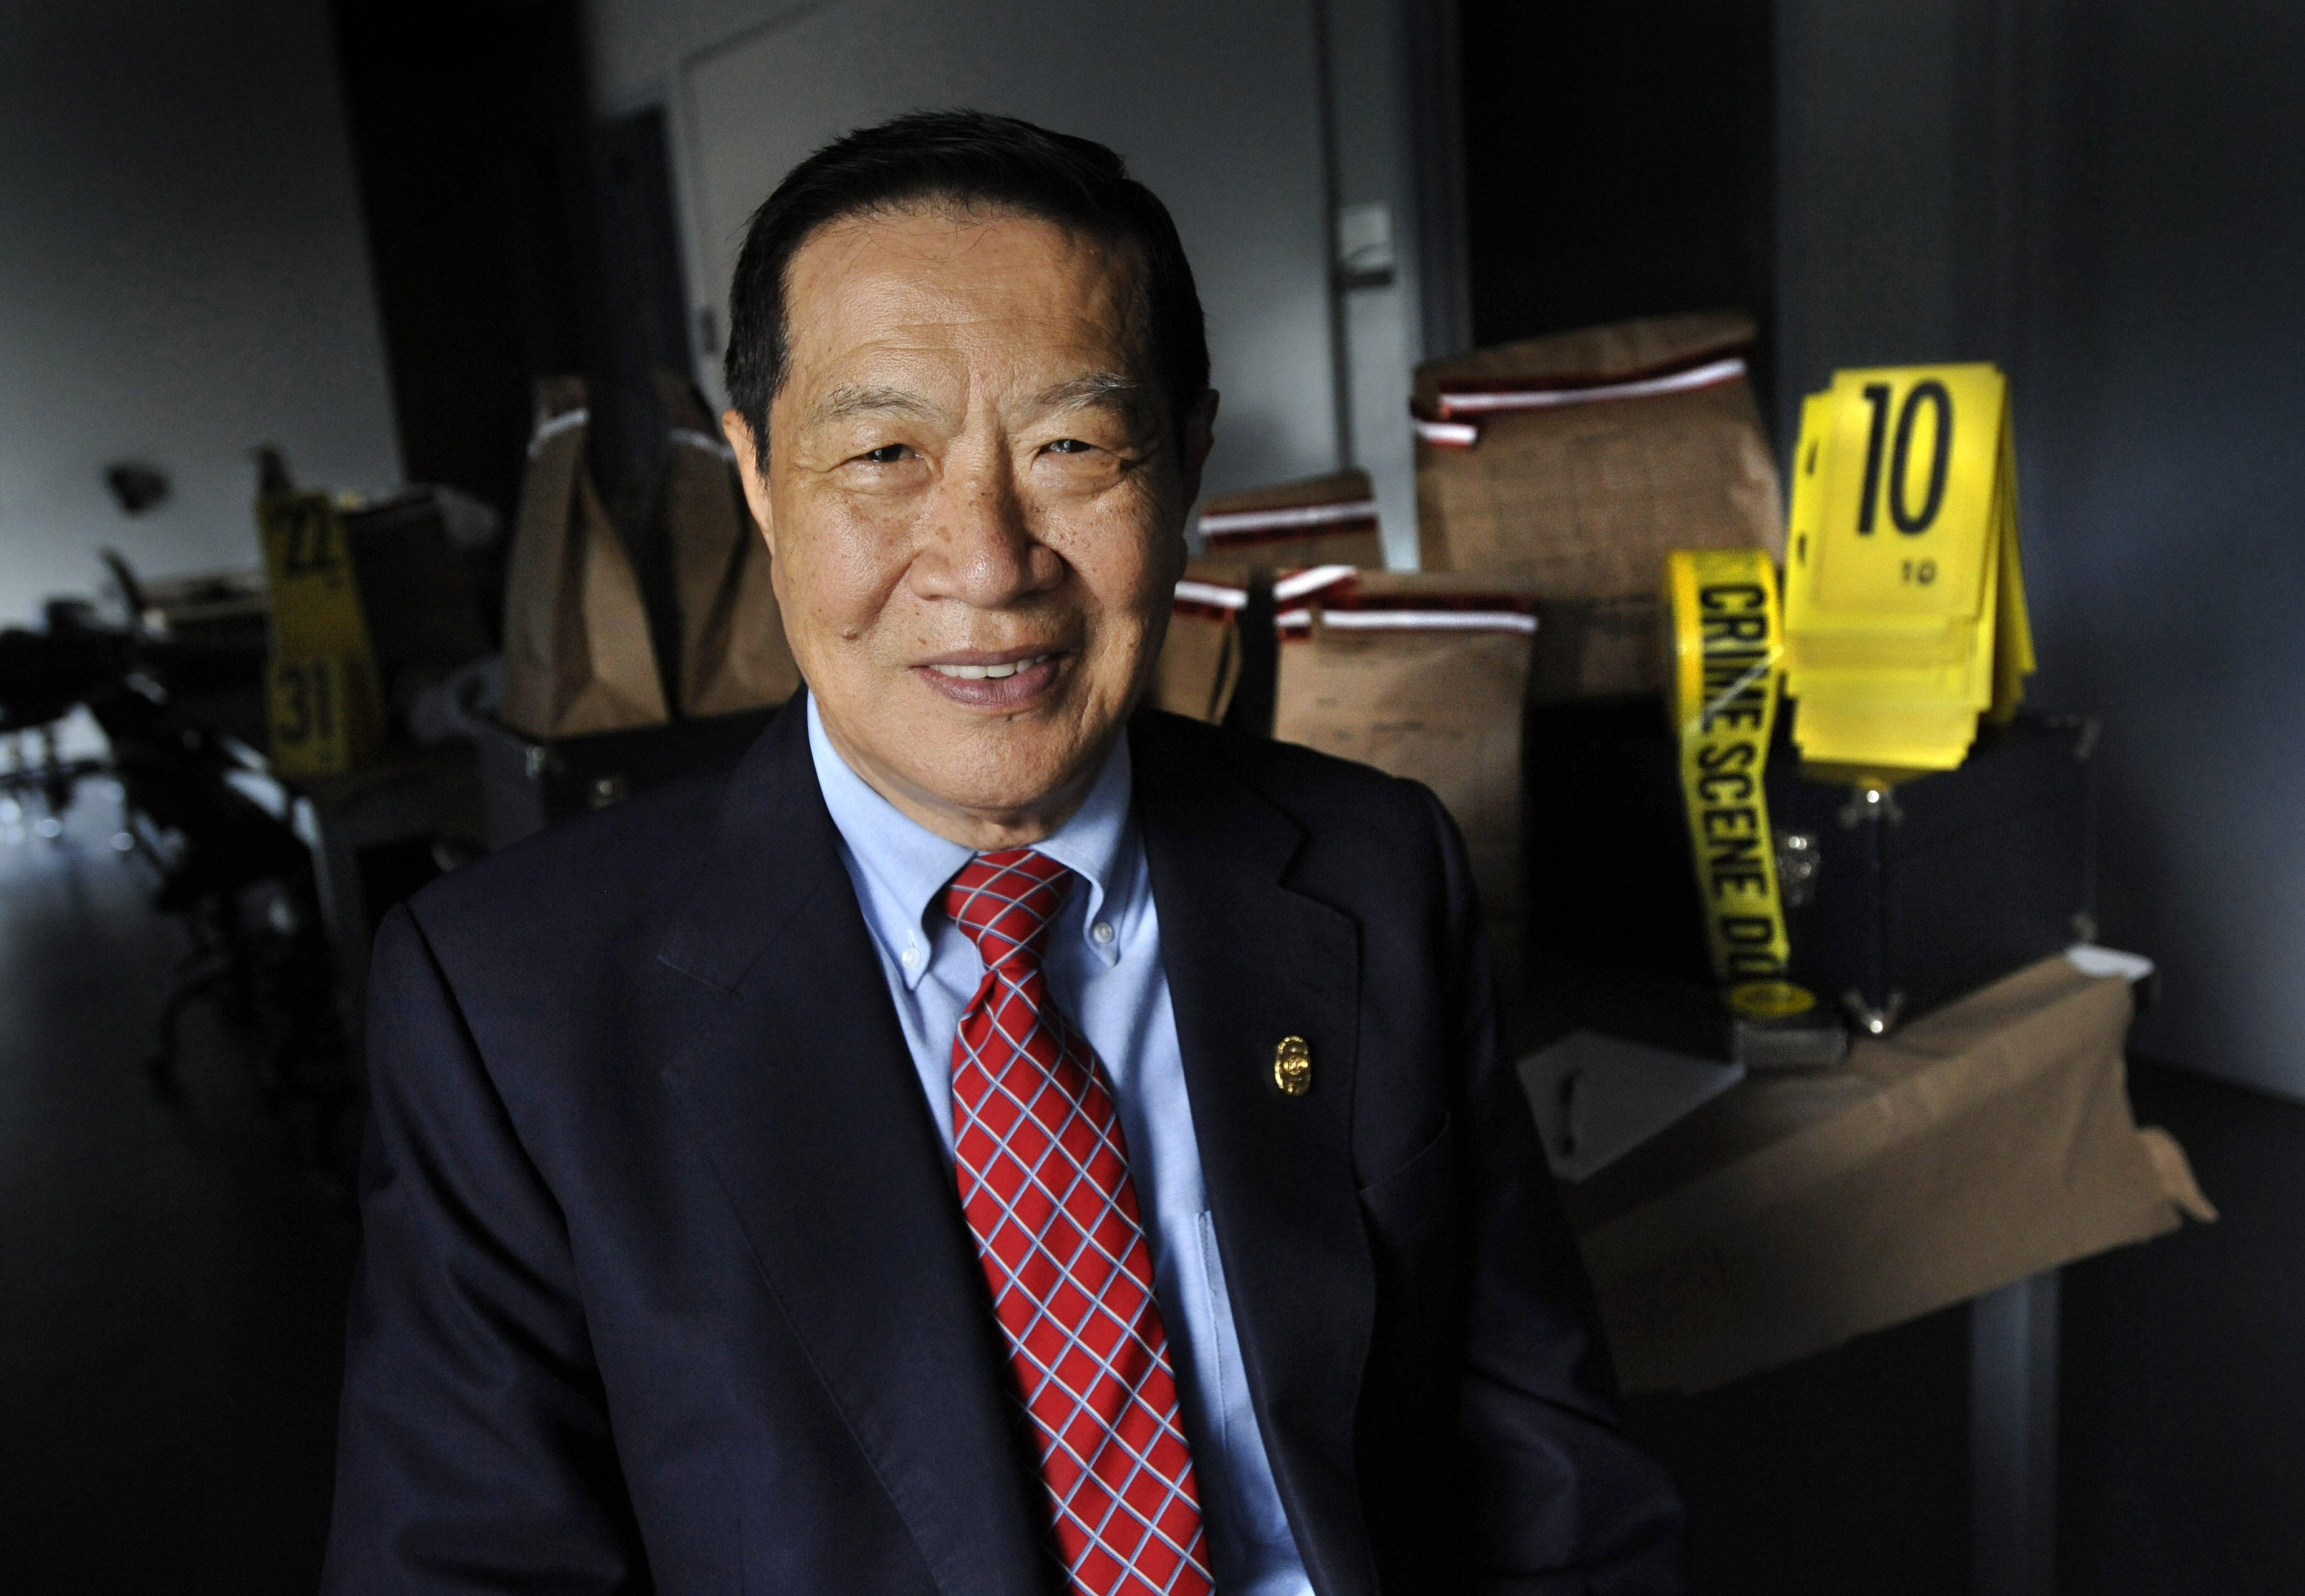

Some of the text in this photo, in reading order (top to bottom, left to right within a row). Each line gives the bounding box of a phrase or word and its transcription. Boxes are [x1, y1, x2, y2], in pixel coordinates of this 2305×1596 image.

[1856, 378, 1954, 536] 10
[270, 496, 334, 576] 22
[1901, 559, 1938, 584] 10
[274, 662, 335, 745] 31
[1700, 584, 1769, 733] CRIME
[1698, 741, 1769, 900] SCENE
